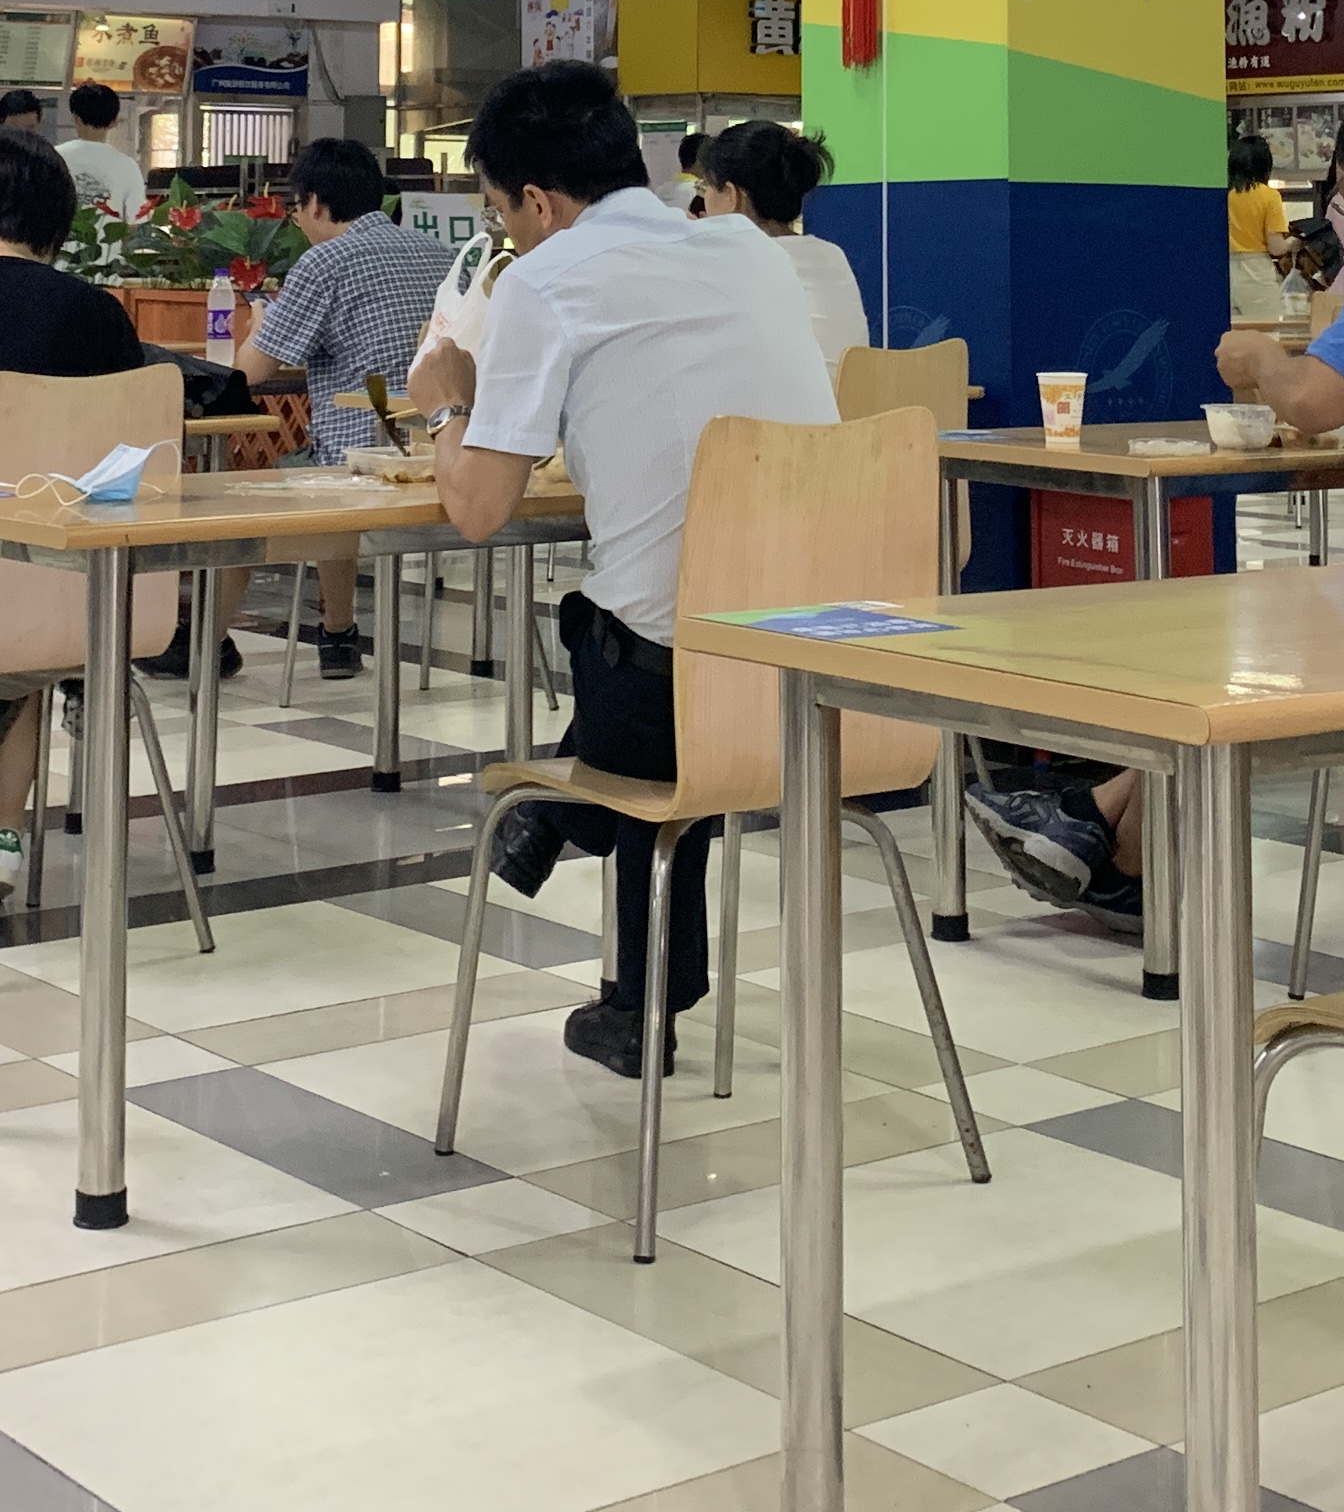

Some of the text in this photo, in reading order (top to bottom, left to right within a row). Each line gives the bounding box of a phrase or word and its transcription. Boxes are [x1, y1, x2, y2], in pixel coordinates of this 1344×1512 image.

[413, 211, 475, 244] 出口
[1061, 528, 1119, 554] 灭火器箱
